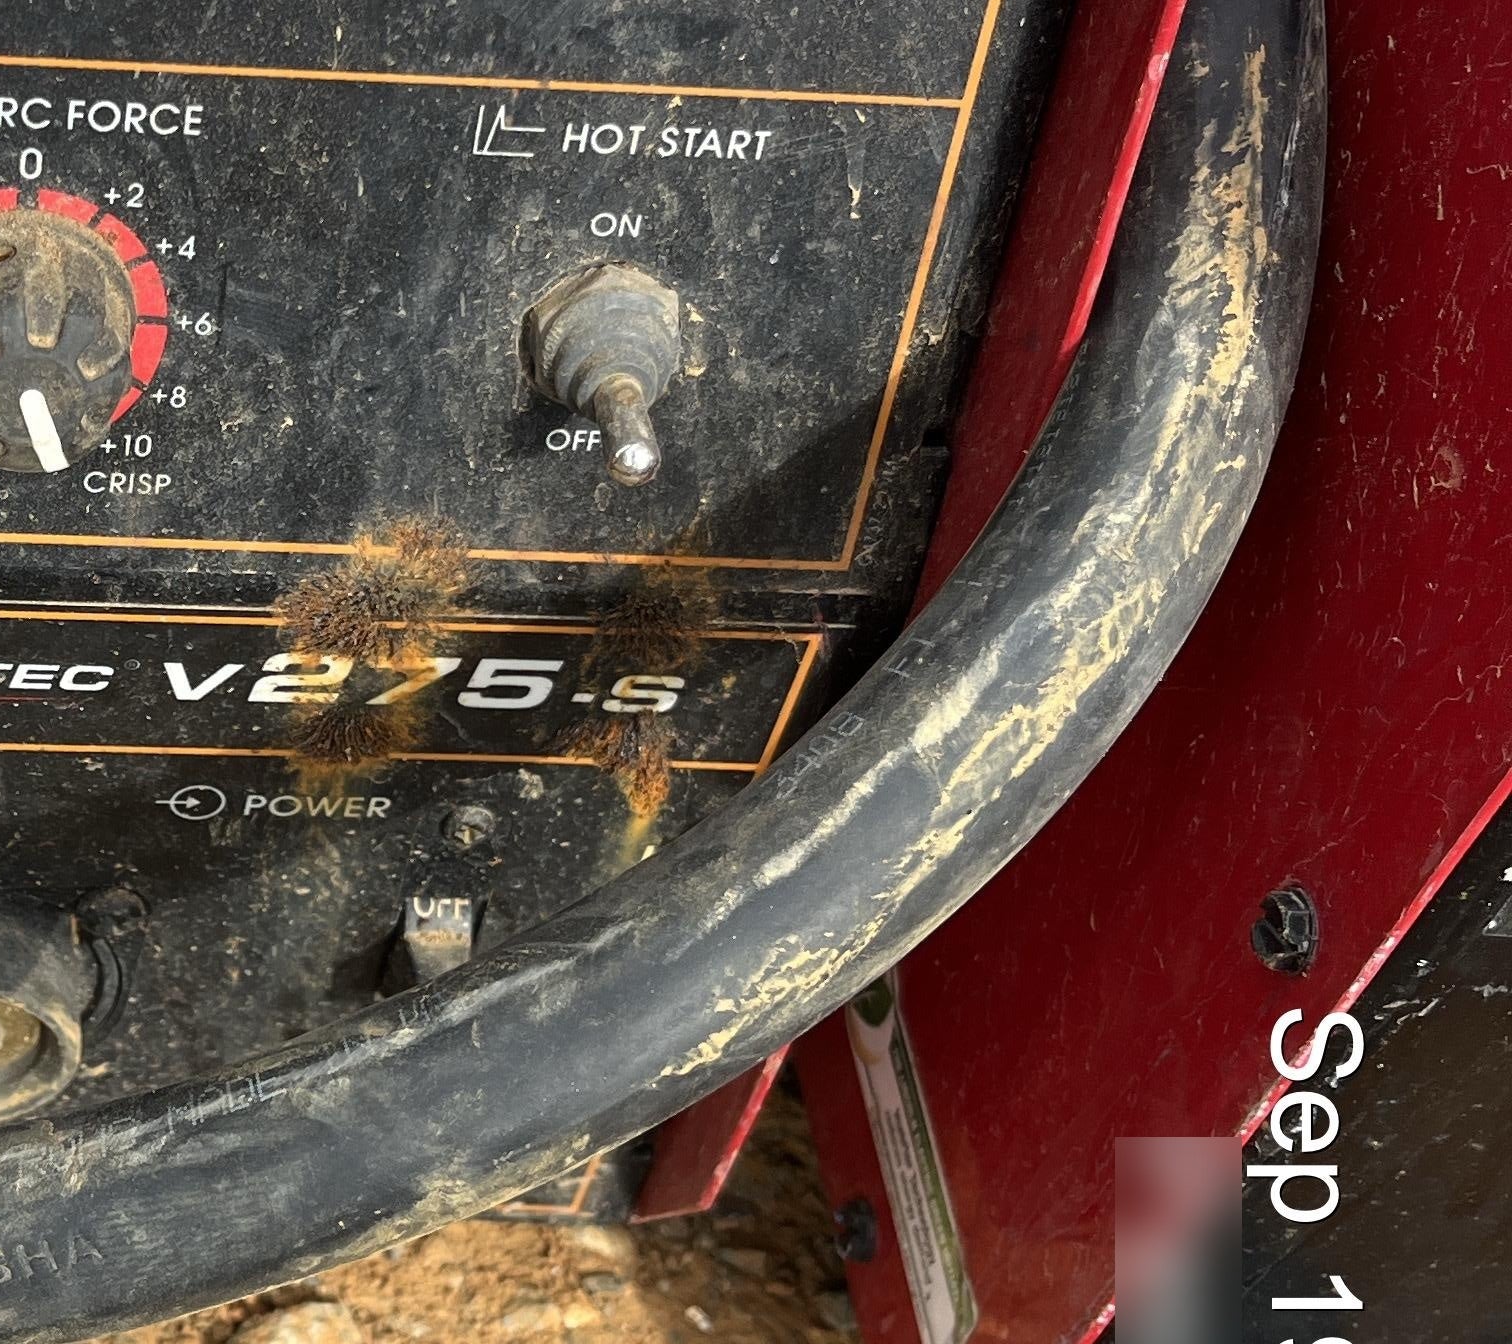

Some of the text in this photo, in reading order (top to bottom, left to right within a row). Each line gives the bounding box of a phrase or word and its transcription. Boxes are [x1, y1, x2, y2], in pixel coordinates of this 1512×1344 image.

[66, 98, 204, 137] FORCE
[562, 123, 772, 161] HOT START
[19, 148, 44, 180] 0
[103, 183, 145, 210] +2
[589, 212, 643, 239] ON
[156, 235, 198, 261] +4
[178, 311, 215, 336] +6
[150, 385, 188, 409] +8
[100, 434, 153, 458] +10
[544, 427, 602, 453] OFF
[82, 470, 172, 496] CRISP
[243, 793, 393, 820] POWER
